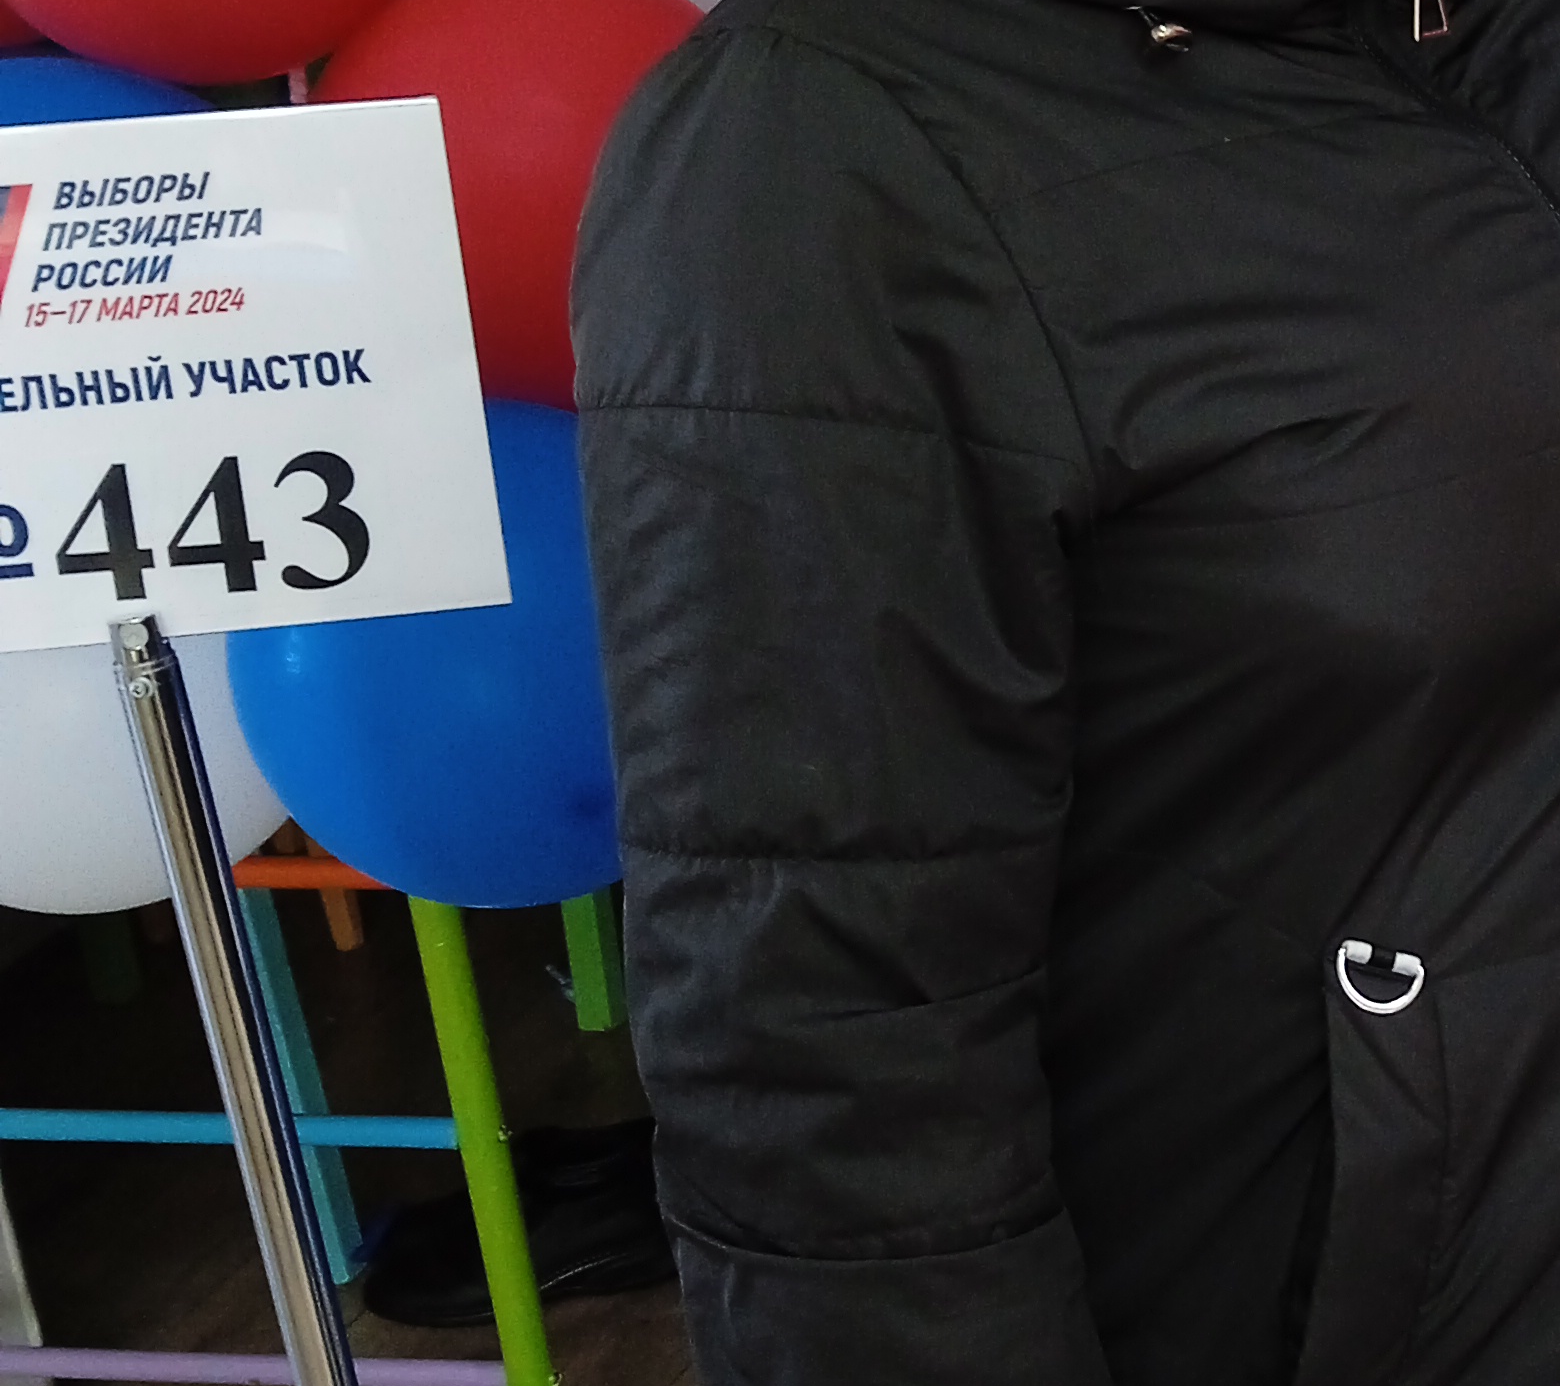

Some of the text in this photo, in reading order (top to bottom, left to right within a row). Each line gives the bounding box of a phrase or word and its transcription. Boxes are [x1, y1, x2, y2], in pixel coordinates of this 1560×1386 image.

[52, 171, 211, 211] ВЫБОРЫ
[41, 207, 264, 253] ПРЕЗИДЕНТА
[31, 254, 174, 294] РОССИИ
[96, 291, 181, 324] МАРТА
[185, 286, 246, 316] 2024
[182, 347, 372, 399] УЧАСТОК
[55, 450, 371, 601] 443
